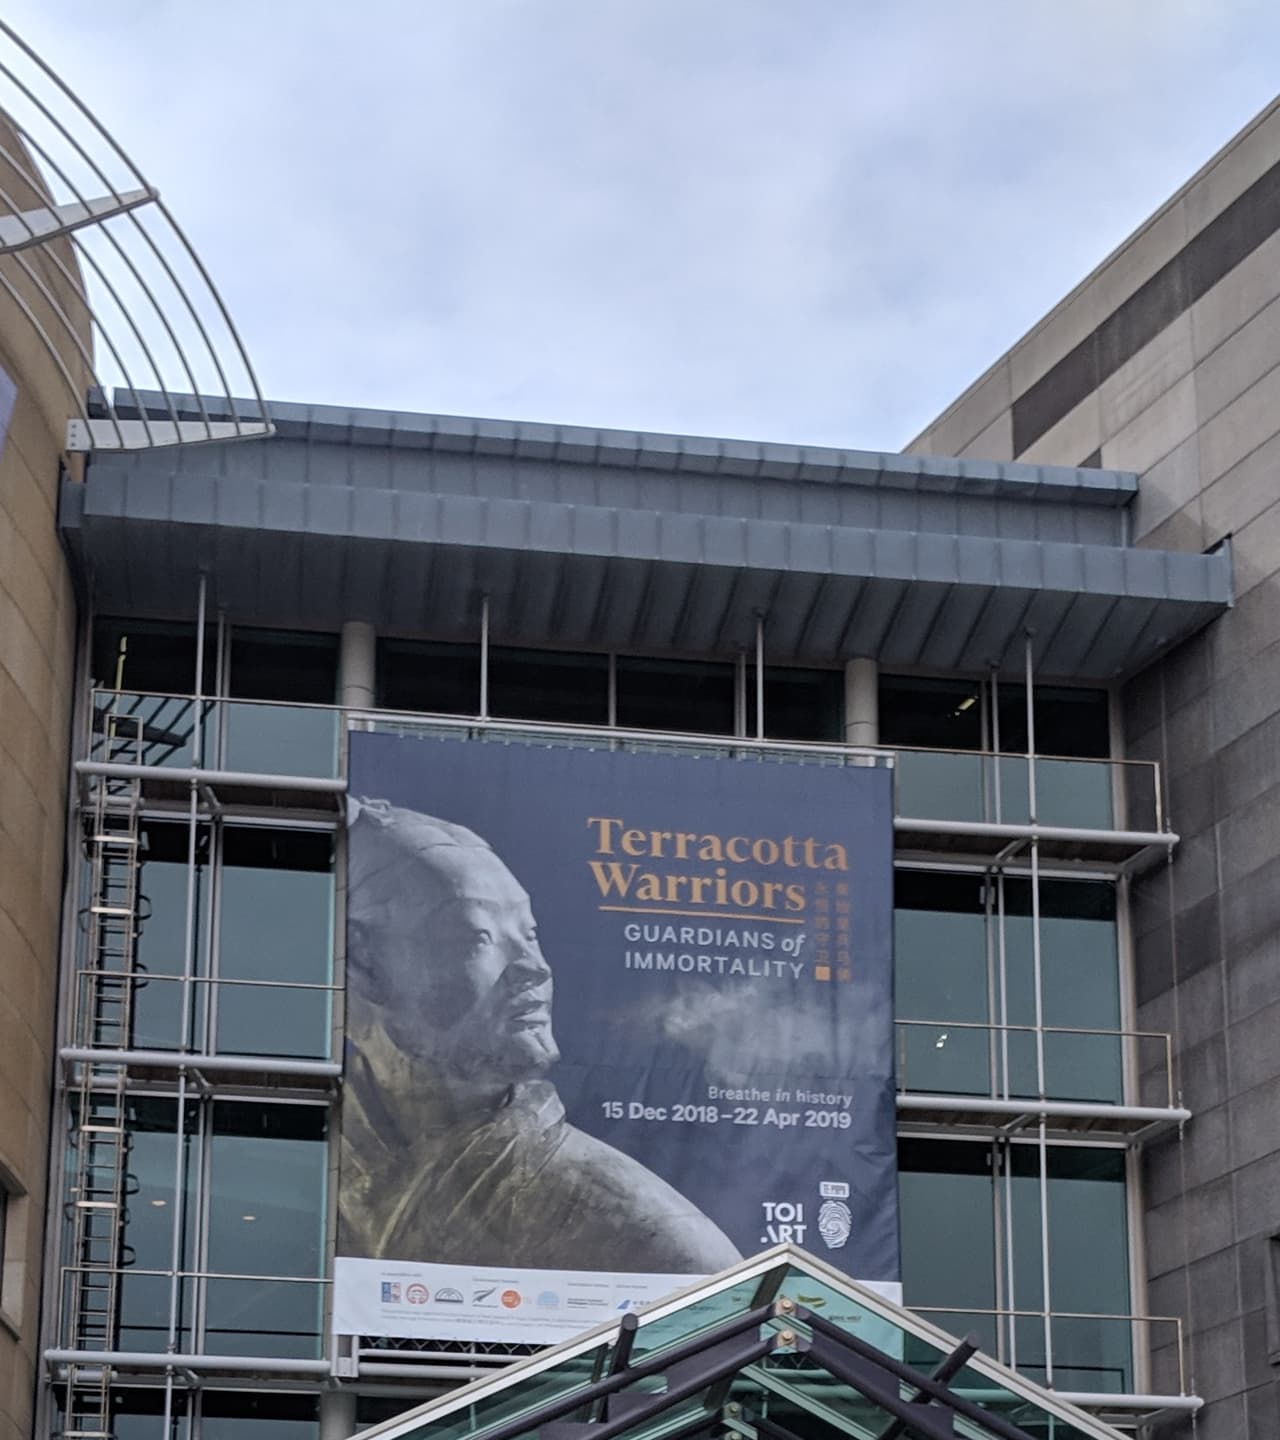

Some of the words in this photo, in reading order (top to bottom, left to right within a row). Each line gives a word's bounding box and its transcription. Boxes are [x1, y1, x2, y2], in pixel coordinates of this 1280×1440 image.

[586, 817, 849, 871] Terracotta
[587, 860, 806, 912] Warriors
[624, 923, 775, 950] GUARDIANS
[781, 933, 806, 957] of
[625, 951, 805, 979] IMMORTALITY
[708, 1086, 770, 1102] Breathe
[776, 1088, 790, 1102] in
[796, 1089, 853, 1108] history
[602, 1102, 624, 1119] 15
[629, 1102, 667, 1120] Dec
[763, 1108, 801, 1129] Apr
[804, 1110, 852, 1129] 2019
[761, 1202, 803, 1223] TOI
